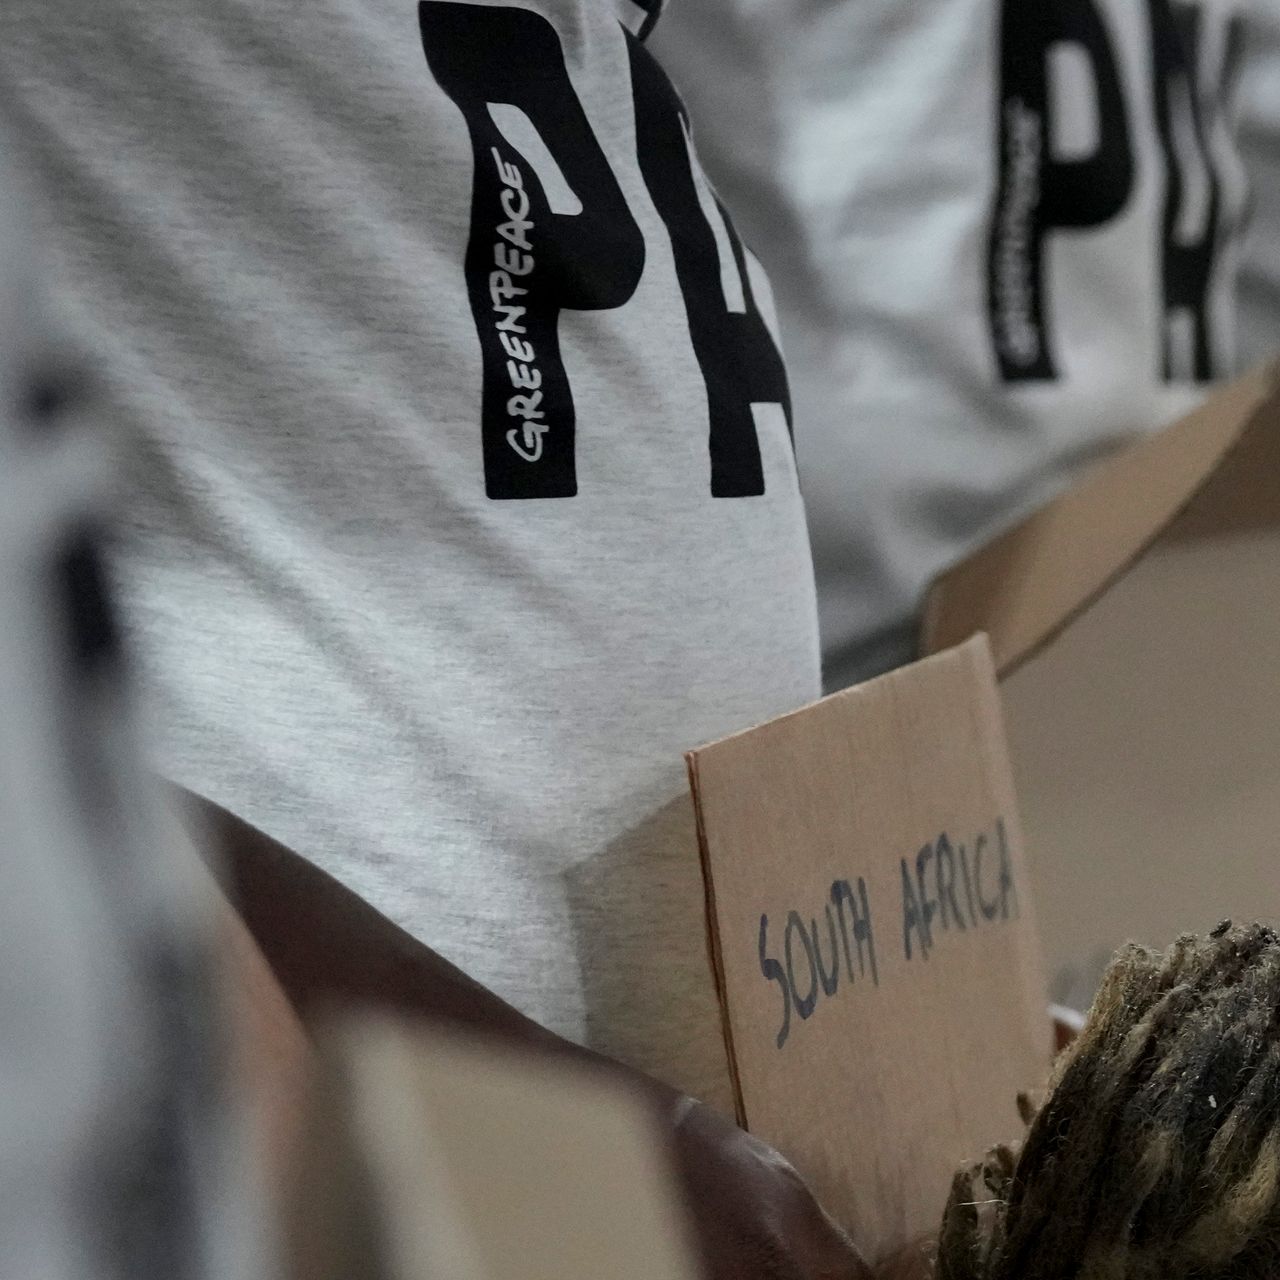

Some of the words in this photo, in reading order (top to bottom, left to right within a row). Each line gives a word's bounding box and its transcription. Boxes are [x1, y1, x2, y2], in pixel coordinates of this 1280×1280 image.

[488, 146, 549, 463] GREENPEACE
[758, 876, 879, 1050] SOUTH
[901, 815, 1019, 961] AFRICA
